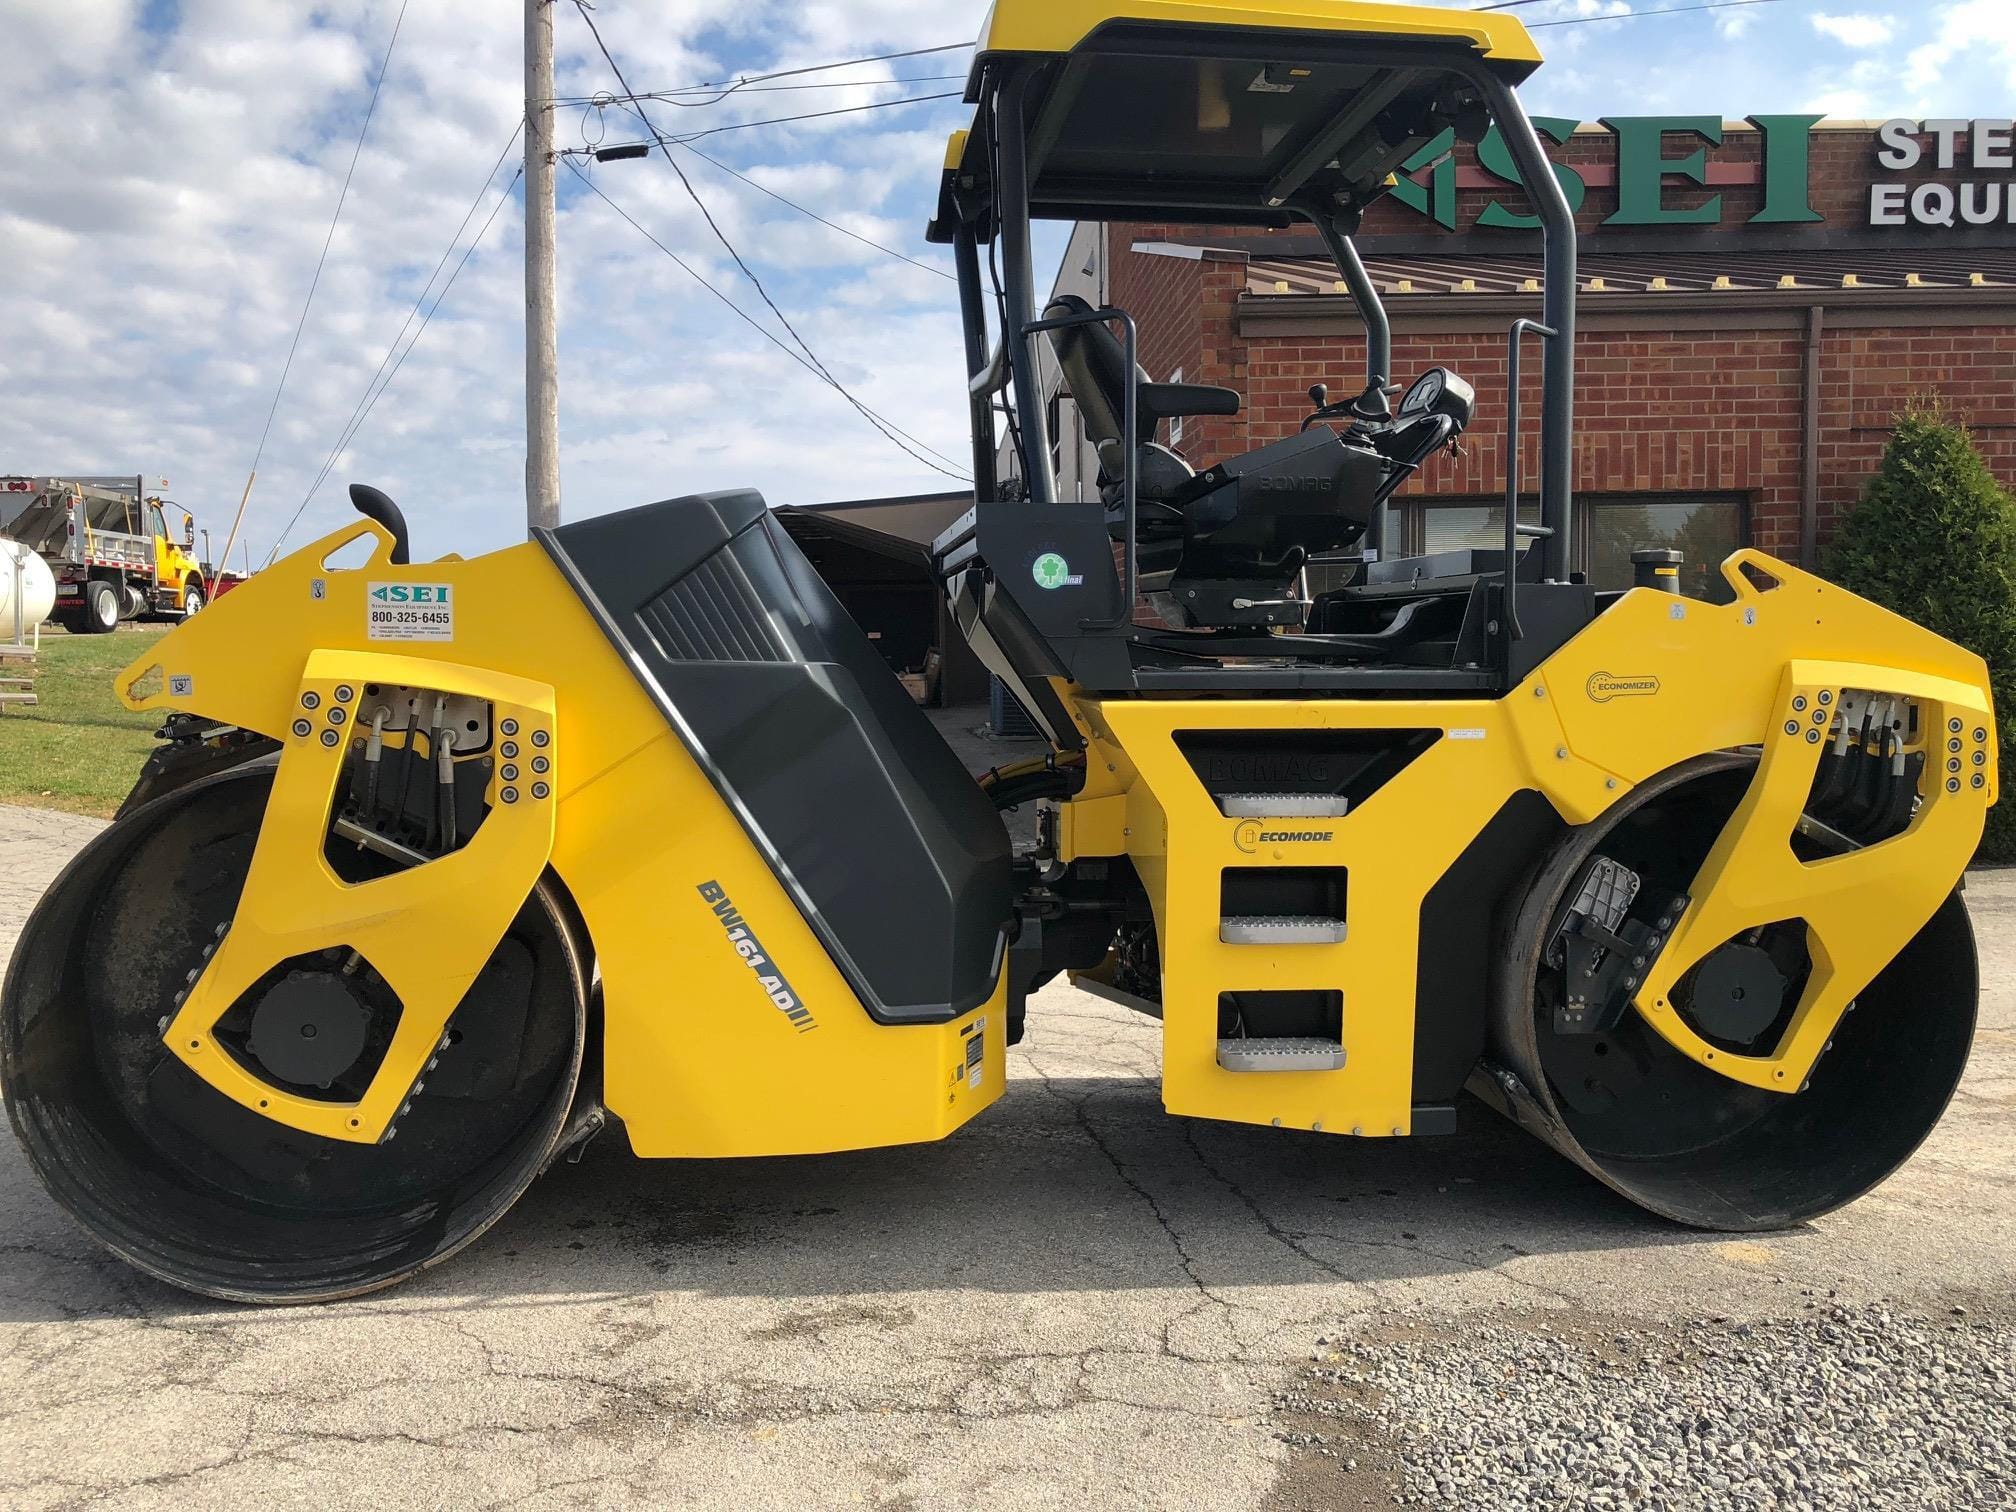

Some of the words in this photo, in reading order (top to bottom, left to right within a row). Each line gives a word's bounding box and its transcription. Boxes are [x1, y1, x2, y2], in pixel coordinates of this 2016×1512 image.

[1877, 118, 2013, 170] STE
[1474, 113, 1828, 229] SEI
[390, 586, 448, 602] SEI
[372, 611, 449, 623] 800-325-6455
[1598, 682, 1655, 690] ECONOMIZER
[1259, 831, 1334, 842] ECOMODE
